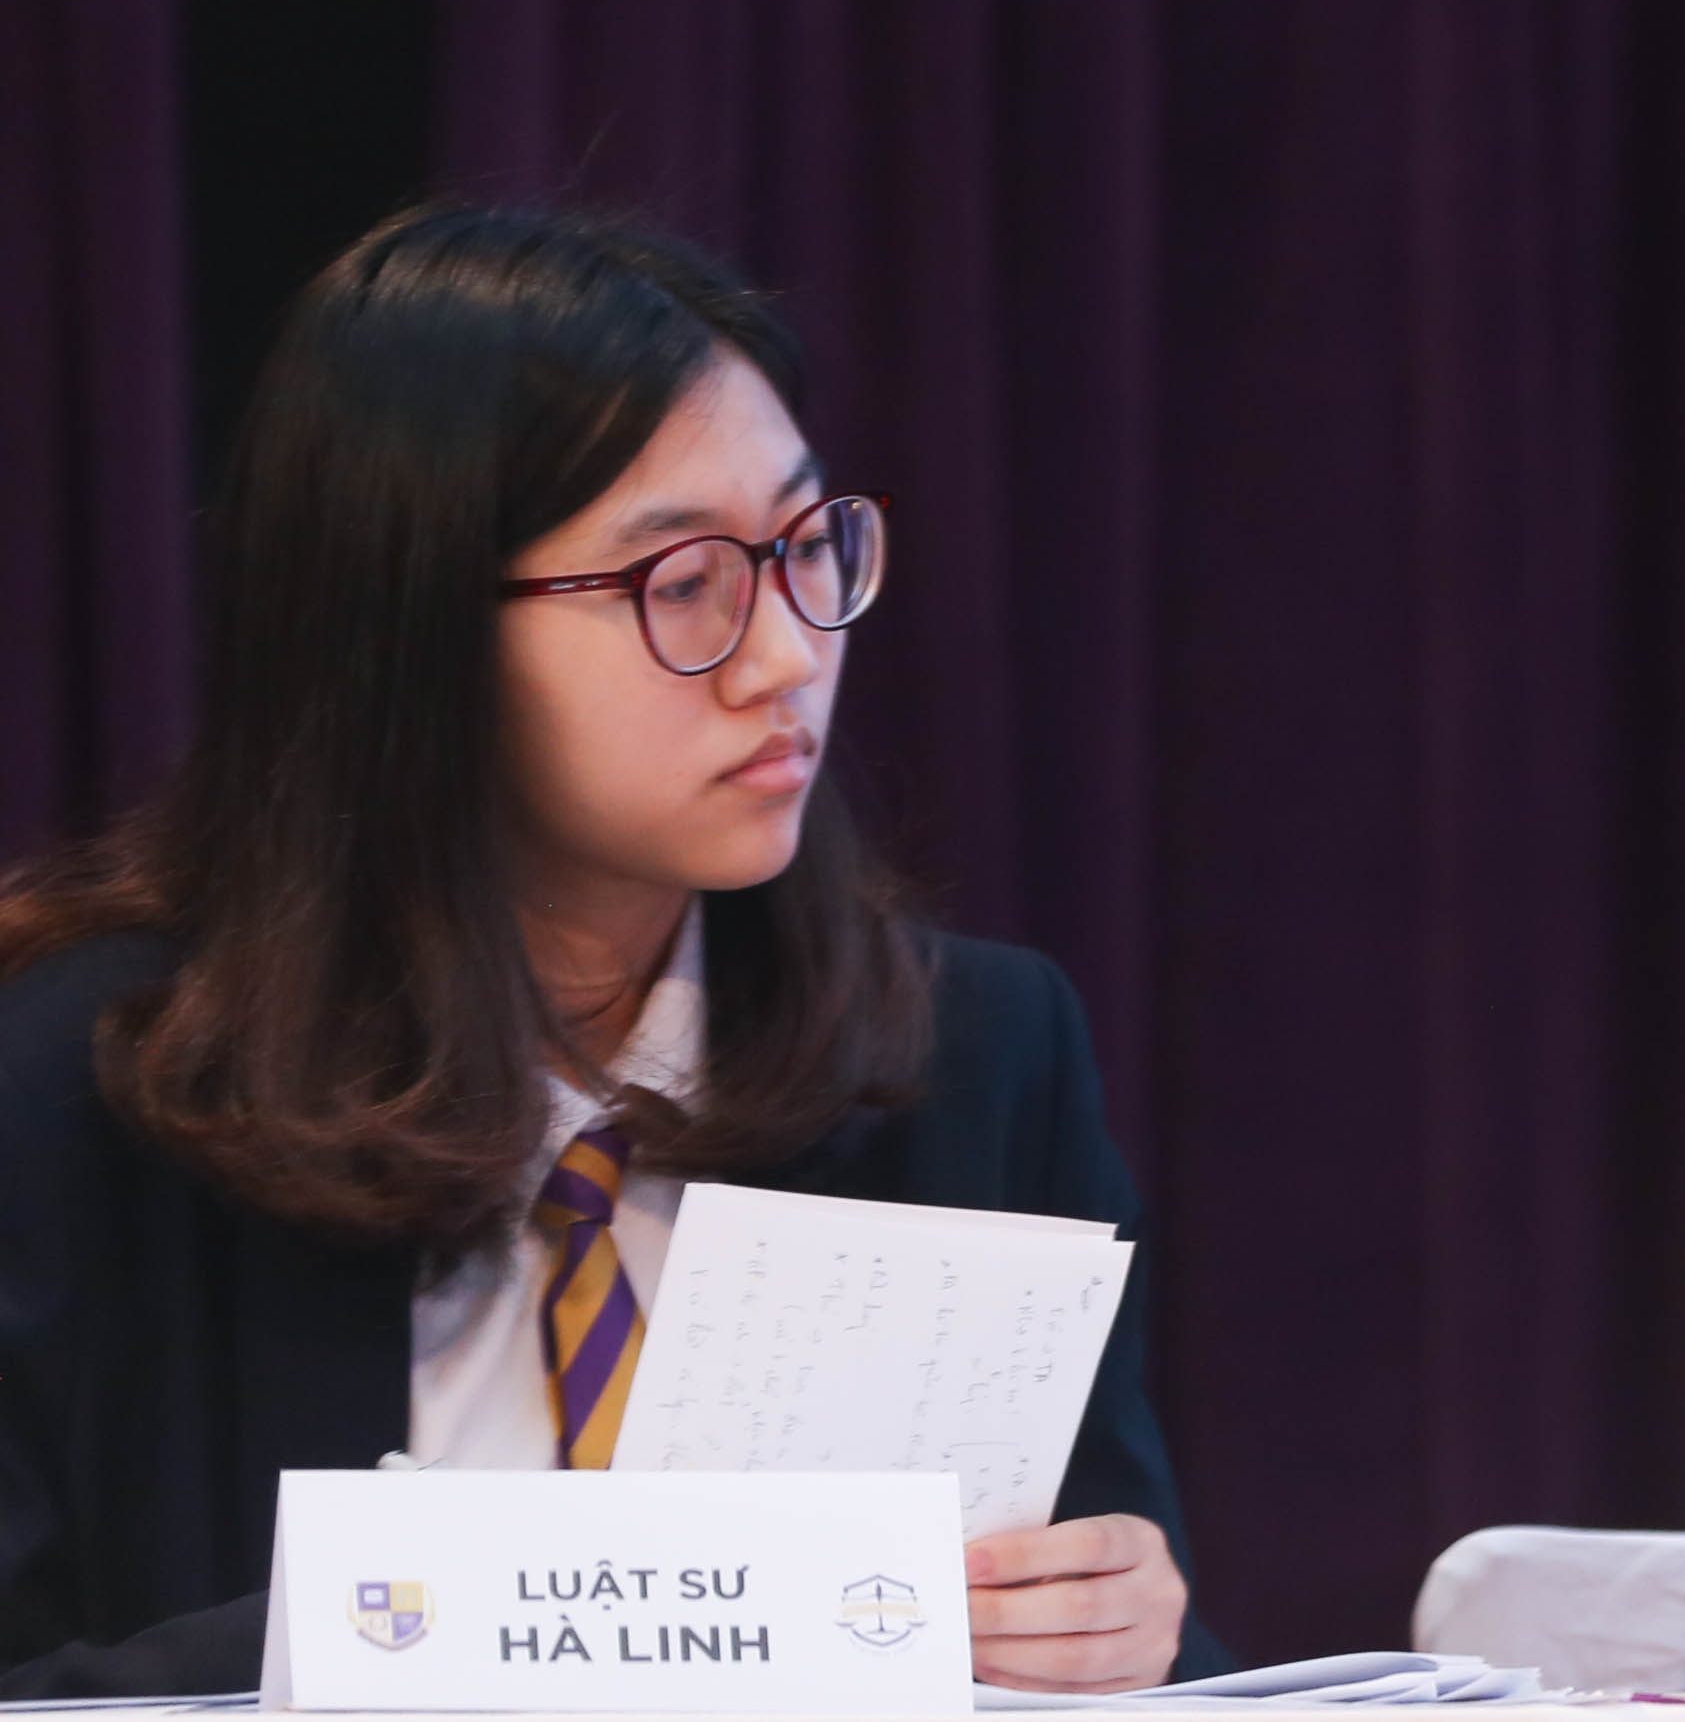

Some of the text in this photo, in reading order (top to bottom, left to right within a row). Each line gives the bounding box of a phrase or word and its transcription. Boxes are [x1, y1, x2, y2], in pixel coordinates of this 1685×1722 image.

[517, 1559, 750, 1611] LUẬT SƯ
[499, 1614, 771, 1663] HÀ LINH
